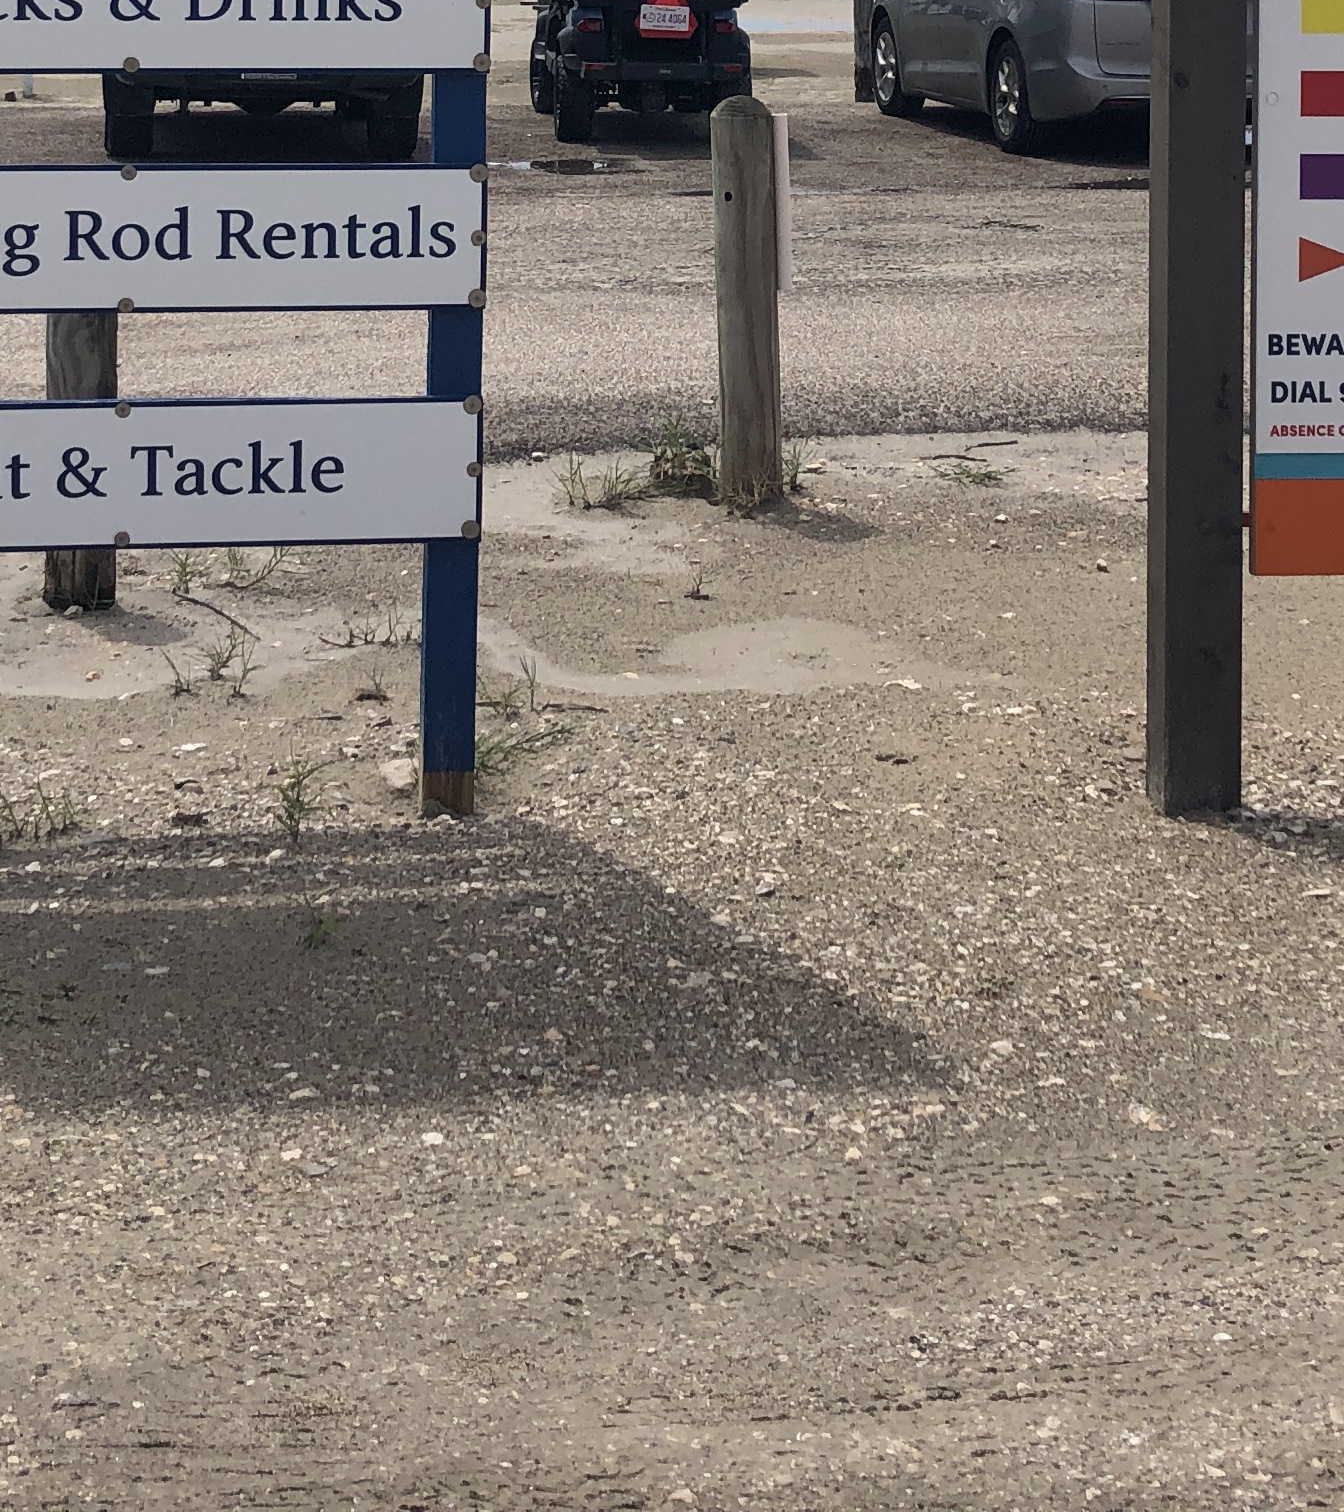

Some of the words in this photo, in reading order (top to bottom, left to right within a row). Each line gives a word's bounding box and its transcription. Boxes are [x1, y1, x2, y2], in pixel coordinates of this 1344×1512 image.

[63, 205, 193, 262] Rod
[215, 204, 457, 260] Rentals
[1270, 380, 1333, 404] DIAL
[1269, 424, 1335, 438] ABSENCE
[56, 446, 108, 499] &
[130, 439, 345, 497] Tackle
